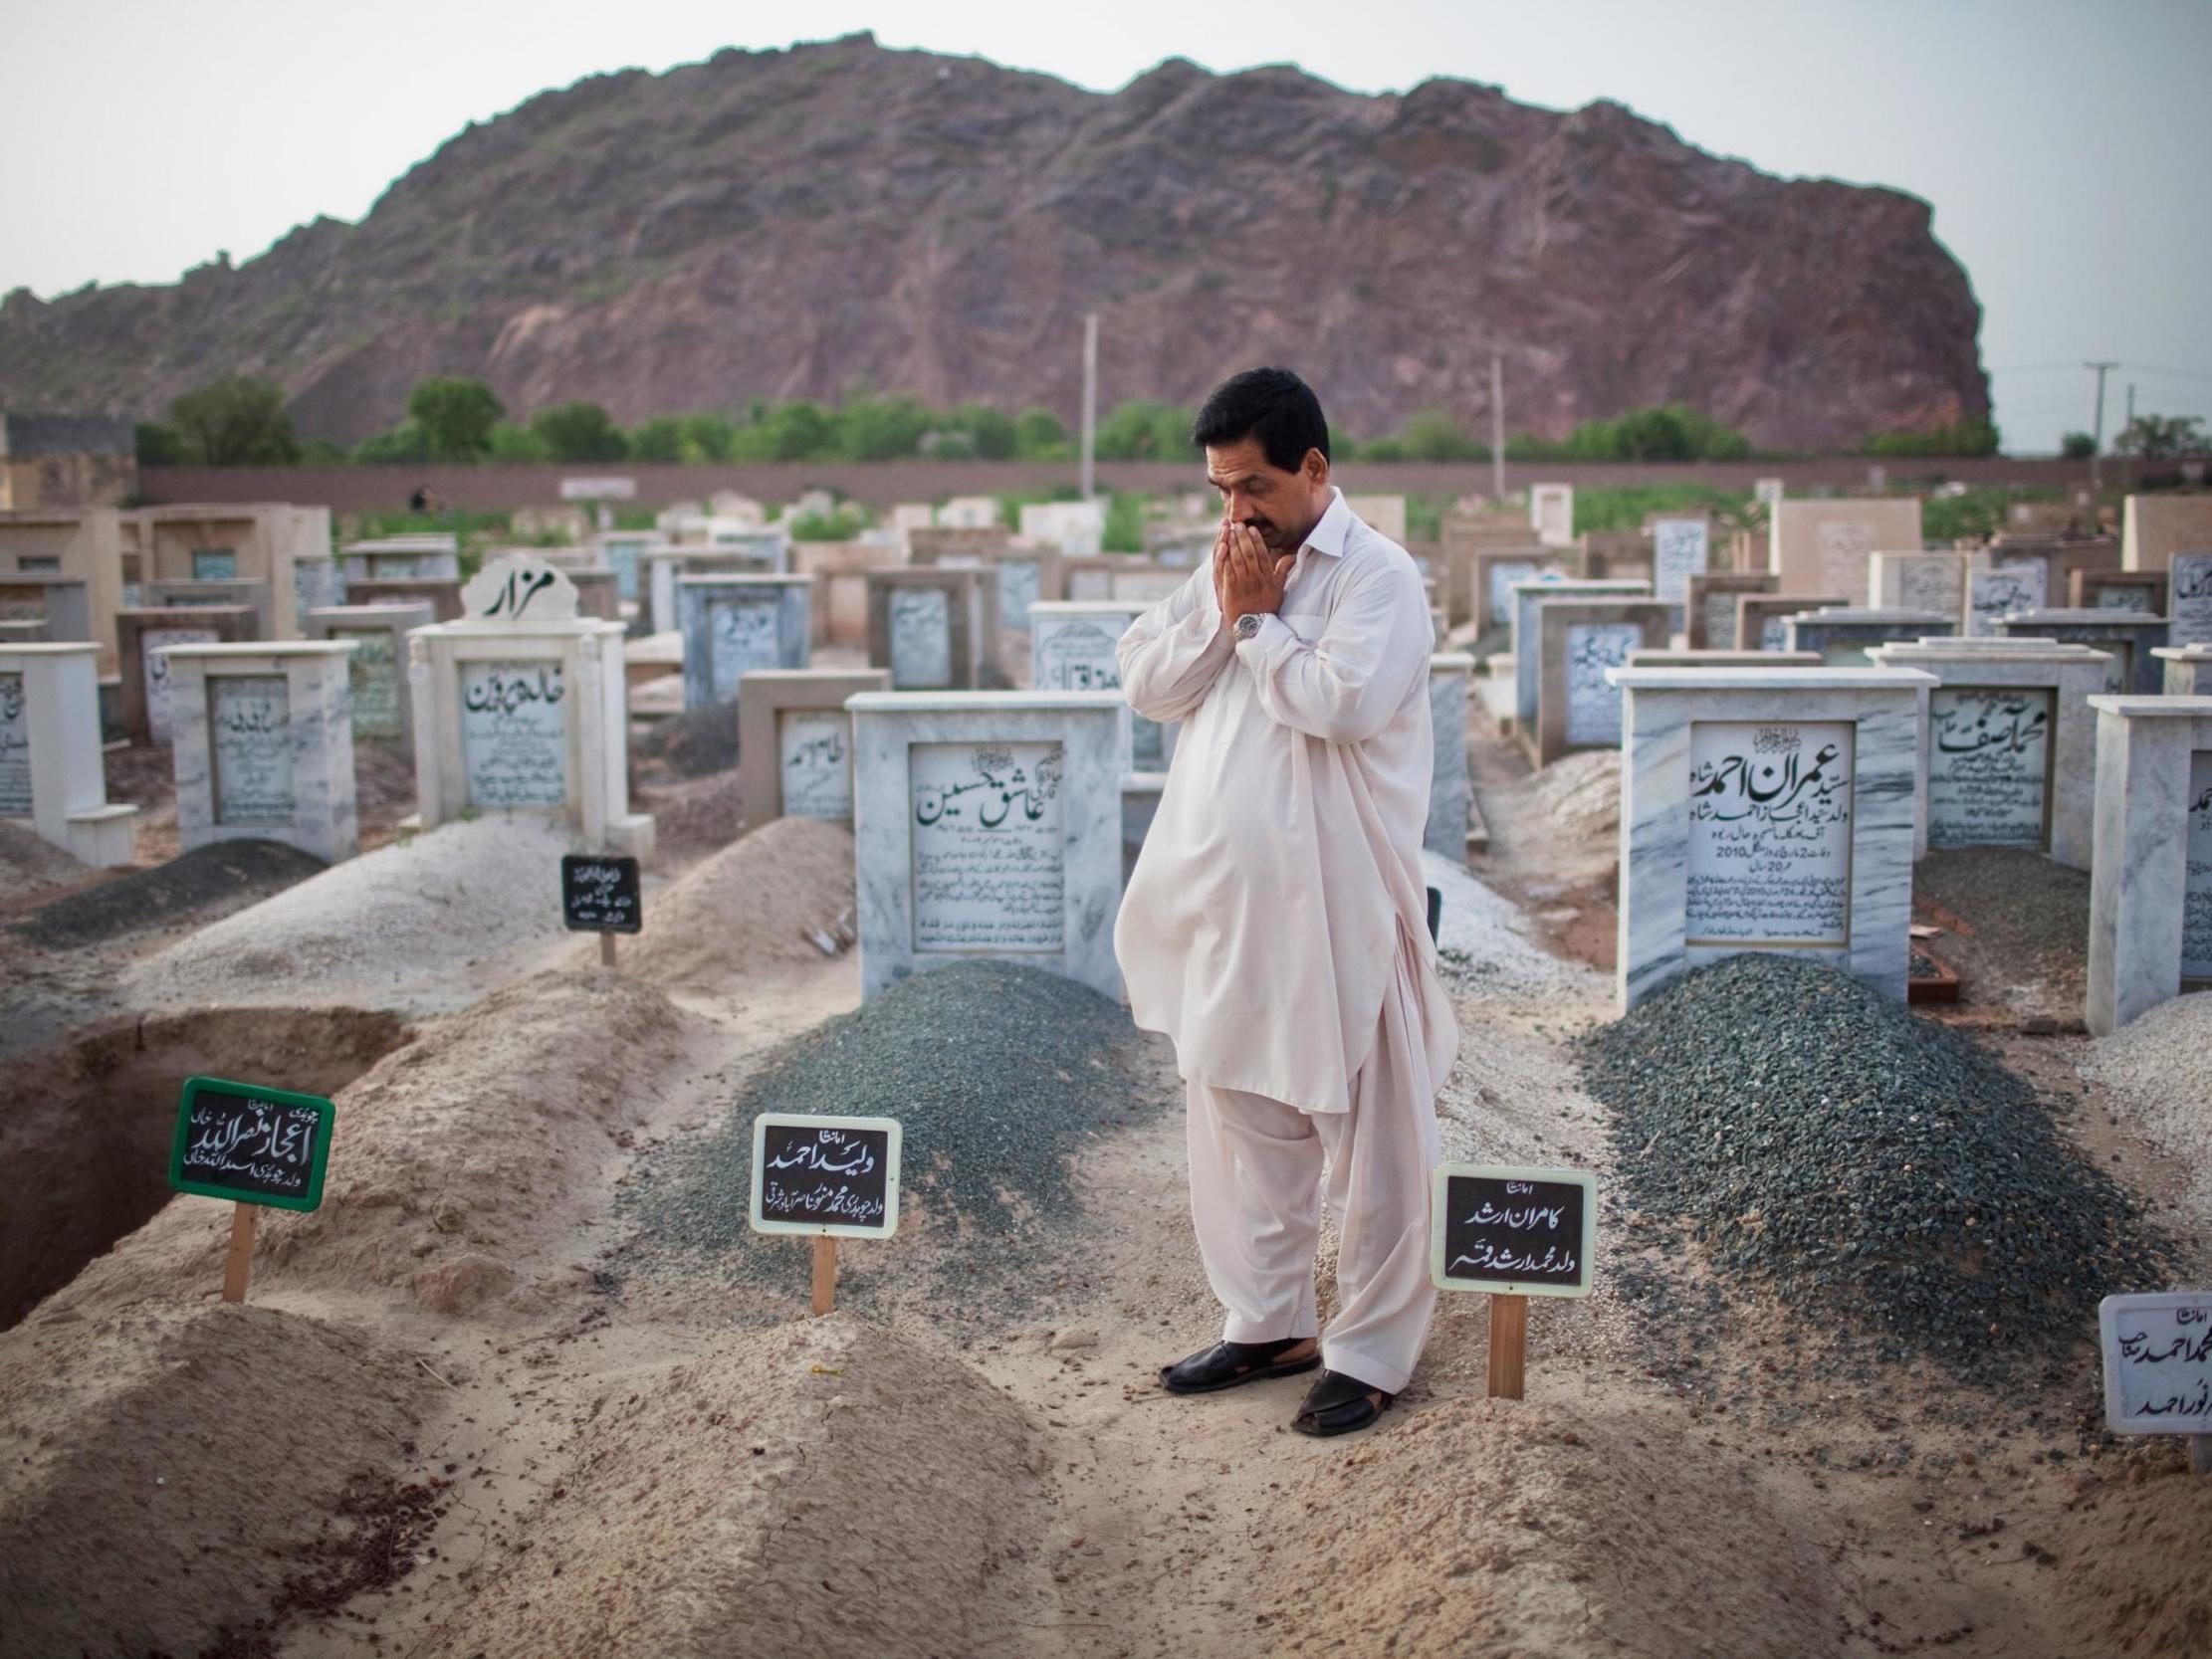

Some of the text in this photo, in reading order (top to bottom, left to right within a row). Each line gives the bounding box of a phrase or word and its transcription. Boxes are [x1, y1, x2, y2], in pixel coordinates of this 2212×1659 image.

[482, 569, 554, 621] مزار
[1938, 702, 2032, 752] آصف
[1996, 711, 2048, 755] محمد
[1689, 760, 1713, 783] شاہ
[1691, 754, 1748, 797] احمد
[1747, 743, 1840, 810] عمران
[916, 768, 1045, 828] عاشق حسین
[1689, 800, 1712, 821] شاہ
[1709, 804, 1760, 821] احمد
[1758, 800, 1810, 825] اعجاز
[1826, 804, 1849, 823] ولد
[1716, 846, 1746, 859] 2010
[1768, 861, 1784, 873] 20
[251, 1114, 313, 1166] اعجاز
[766, 1141, 874, 1176] ولید احمد
[280, 1171, 302, 1187] ولد
[766, 1180, 786, 1212] شرقی
[822, 1185, 849, 1213] محمد
[866, 1196, 883, 1215] ولد
[1464, 1201, 1565, 1230] کامران ارشد
[1484, 1248, 1532, 1271] ارشد
[1522, 1245, 1557, 1272] محمد
[1547, 1250, 1576, 1272] ولد
[2133, 1338, 2191, 1363] احمد
[2135, 1396, 2184, 1415] احمد
